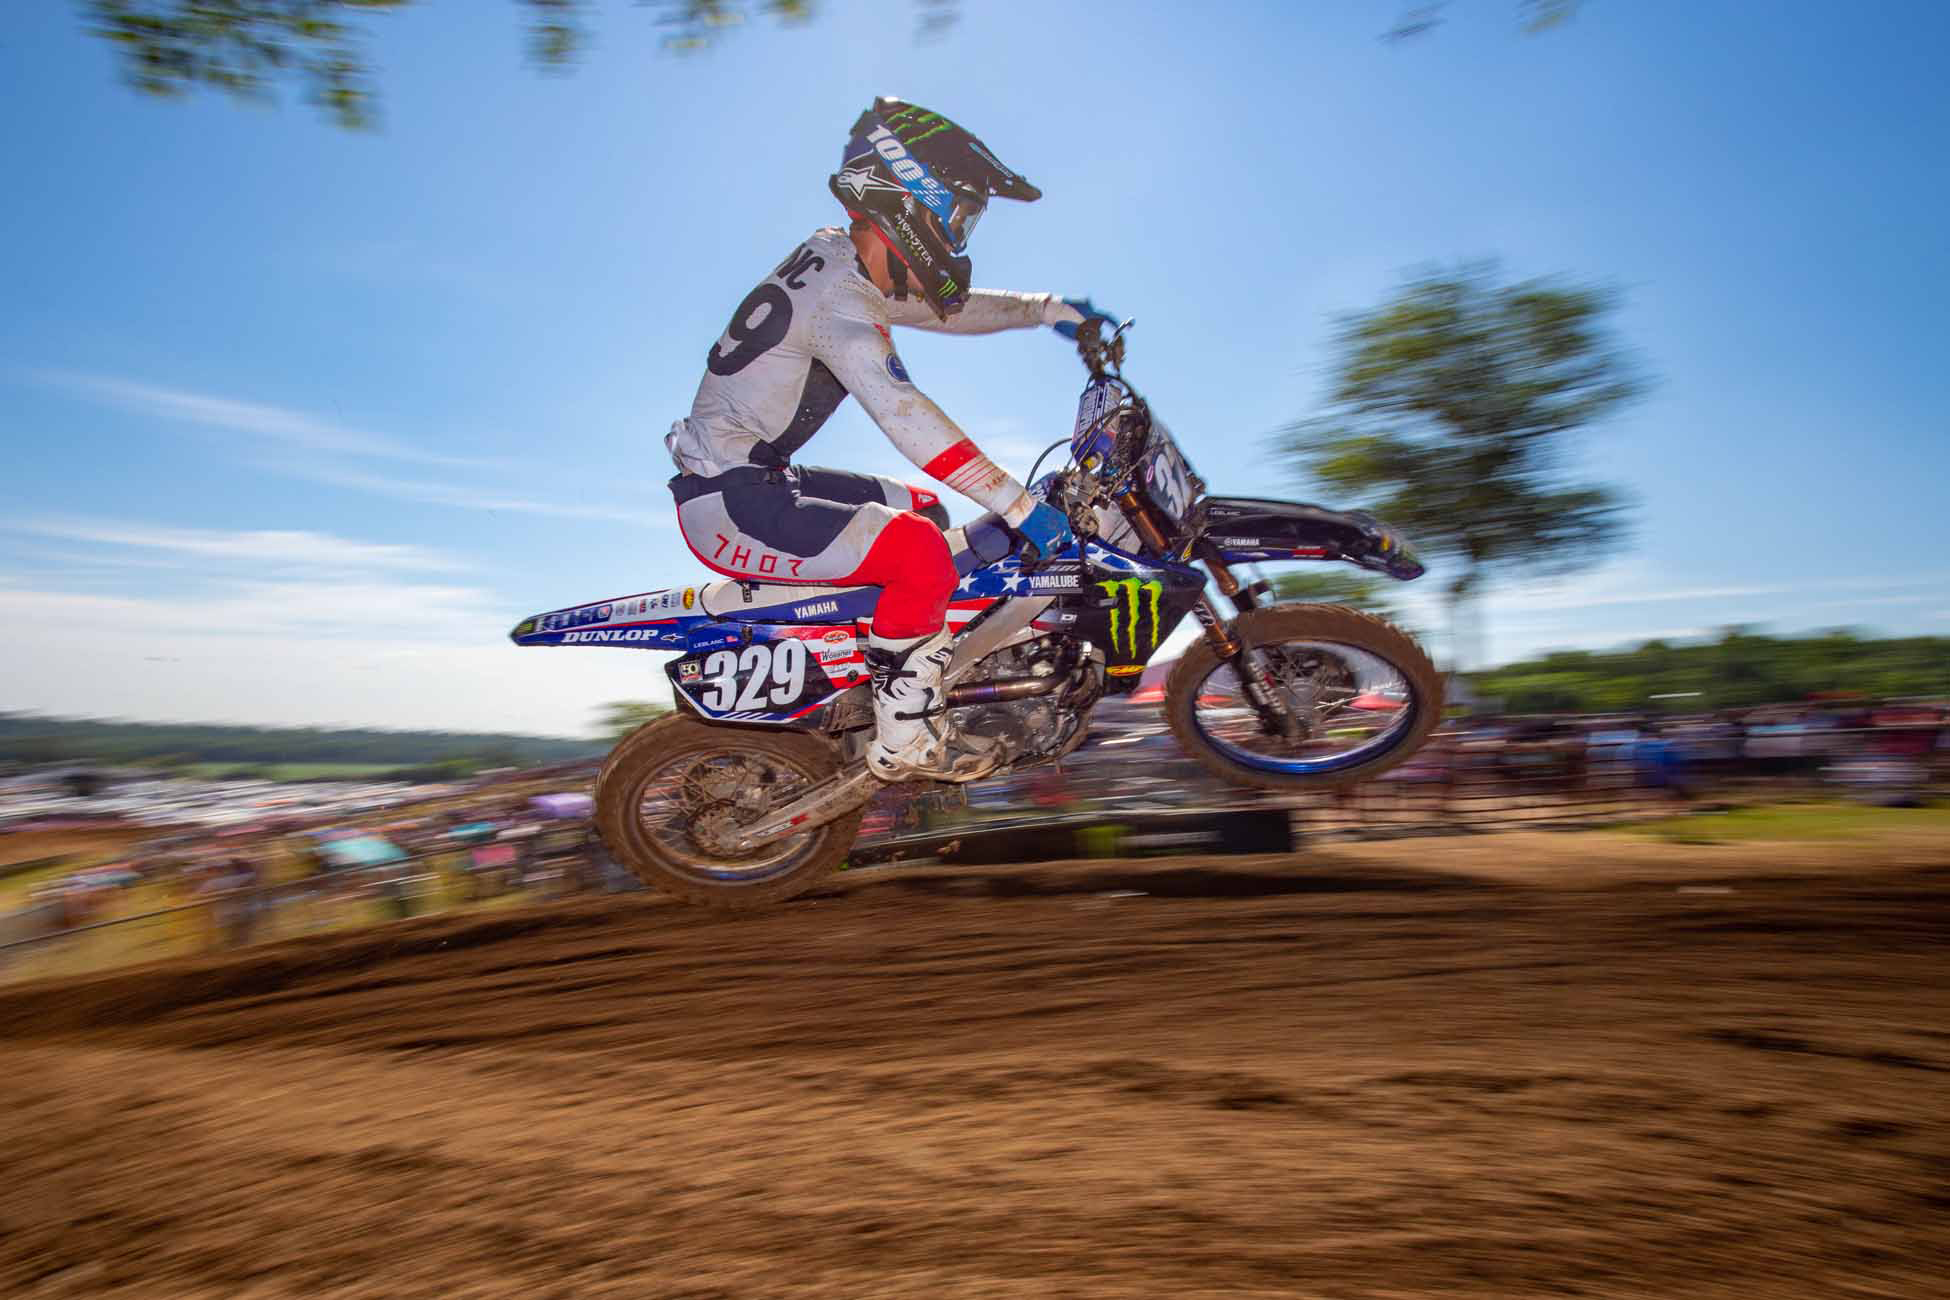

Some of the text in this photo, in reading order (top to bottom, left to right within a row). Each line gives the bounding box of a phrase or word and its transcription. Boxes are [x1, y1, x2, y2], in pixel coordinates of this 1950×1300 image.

[895, 213, 934, 267] MONSTER
[707, 283, 793, 377] 9
[1232, 538, 1260, 546] YAMAHA
[1028, 575, 1080, 588] YAMALUBE
[794, 600, 839, 619] YAMAHA
[561, 629, 659, 644] DUNLOP
[693, 638, 725, 649] LEBLANC
[682, 662, 699, 676] 50
[702, 638, 806, 712] 329
